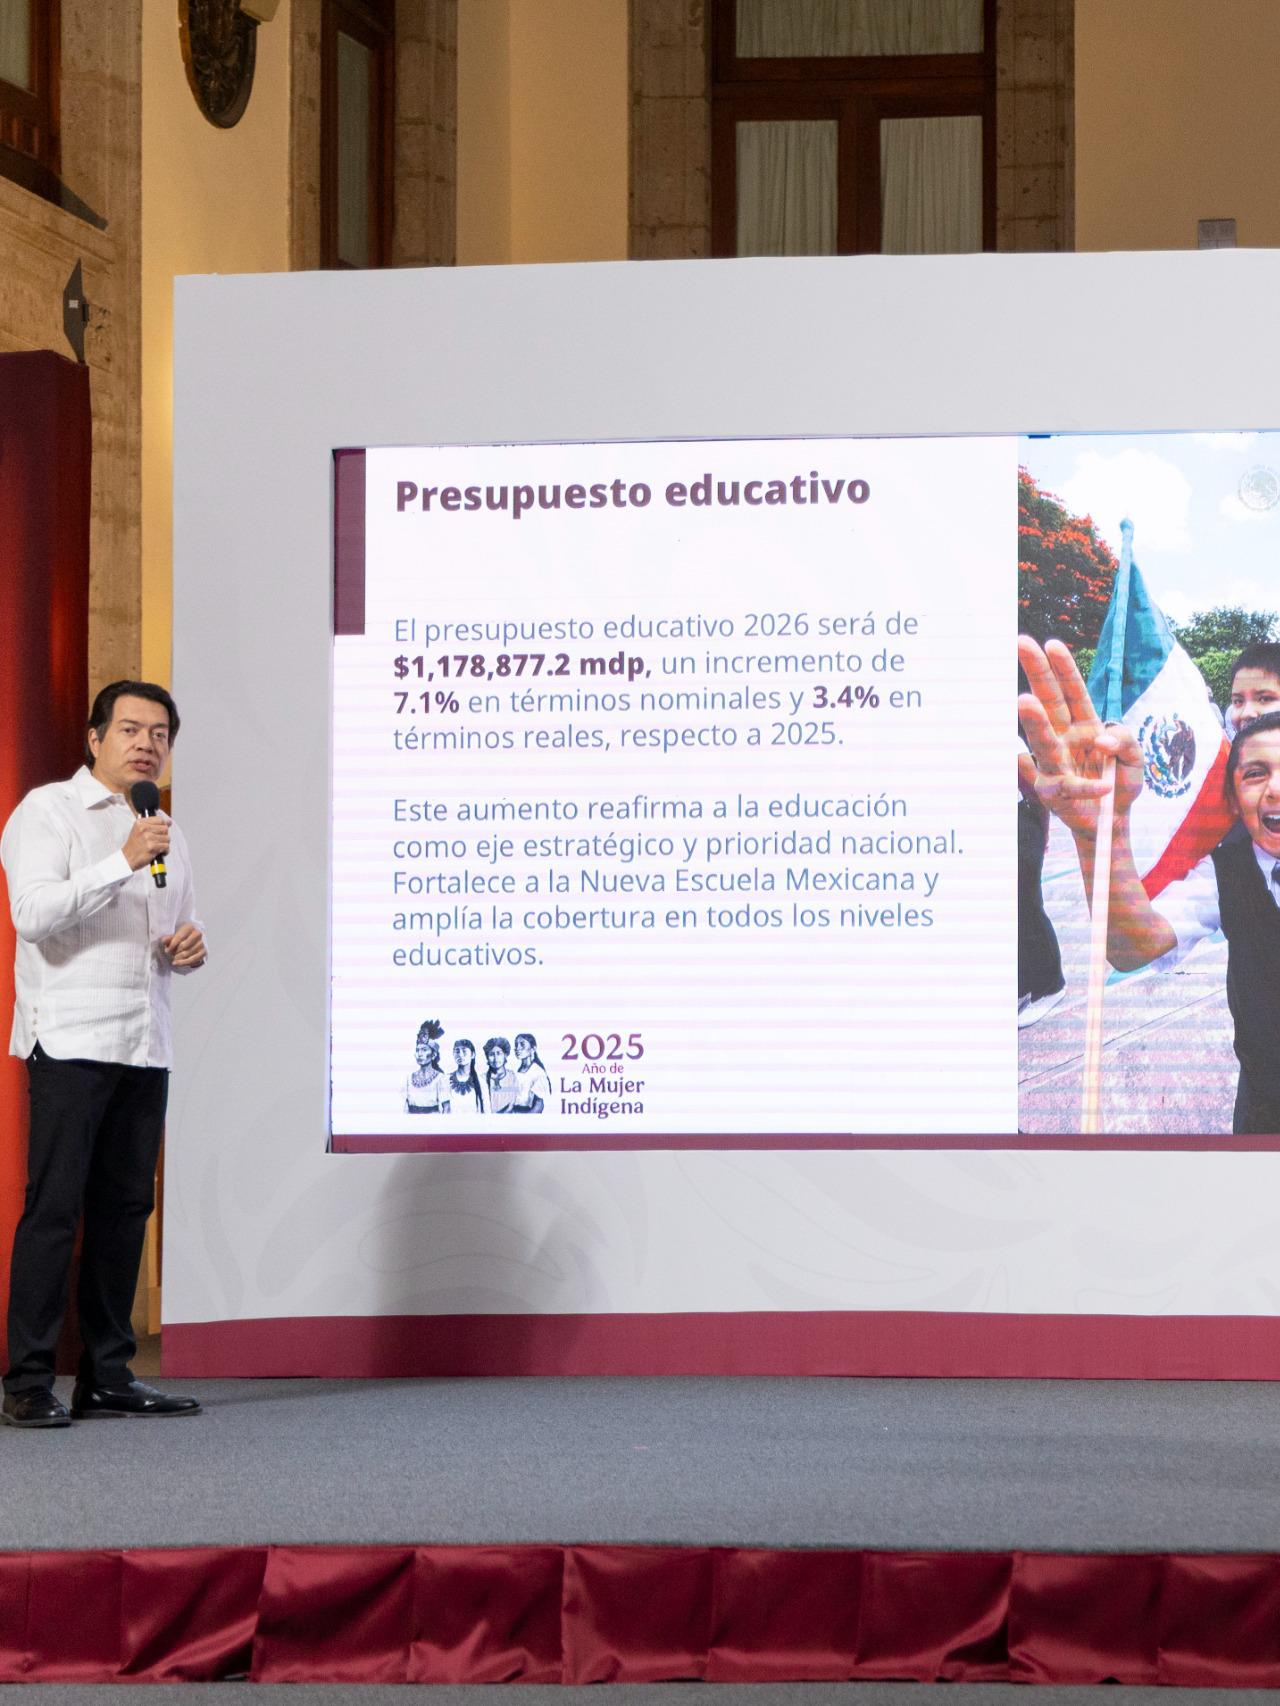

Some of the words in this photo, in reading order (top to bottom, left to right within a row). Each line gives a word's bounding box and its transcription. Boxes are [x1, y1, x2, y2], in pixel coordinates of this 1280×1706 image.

[396, 478, 652, 520] Presupuesto
[664, 470, 871, 508] educativo
[395, 617, 416, 642] El
[425, 618, 594, 649] presupuesto
[603, 613, 735, 639] educativo
[744, 612, 809, 637] 2026
[818, 610, 875, 636] será
[885, 610, 918, 636] de
[393, 652, 571, 683] $1,178,877.2
[579, 650, 652, 683] mdp,
[662, 656, 696, 675] un
[705, 650, 863, 674] incremento
[871, 647, 905, 673] de
[393, 690, 461, 715] 7.1%
[468, 695, 501, 714] en
[509, 687, 632, 713] términos
[640, 685, 782, 711] nominales
[789, 690, 805, 717] y
[812, 685, 882, 710] 3.4%
[888, 689, 923, 709] en
[393, 725, 515, 751] términos
[524, 723, 611, 752] reales,
[621, 724, 738, 754] respecto
[746, 727, 761, 746] a
[770, 721, 844, 746] 2025.
[394, 798, 448, 822] Este
[456, 797, 579, 822] aumento
[588, 794, 703, 820] reafirma
[712, 800, 727, 819] a
[737, 793, 759, 818] la
[768, 792, 907, 818] educación
[393, 839, 467, 859] como
[476, 833, 514, 865] eje
[523, 831, 674, 864] estratégico
[682, 837, 698, 863] y
[706, 829, 831, 863] prioridad
[842, 829, 963, 855] nacional.
[393, 869, 516, 895] Fortalece
[525, 875, 539, 894] a
[549, 868, 570, 893] la
[581, 869, 665, 893] Nueva
[676, 866, 775, 892] Escuela
[786, 867, 915, 891] Mexicana
[923, 872, 940, 898] y
[392, 905, 483, 938] amplía
[492, 904, 513, 930] la
[523, 904, 655, 930] cobertura
[665, 909, 697, 929] en
[706, 903, 783, 928] todos
[793, 902, 831, 928] los
[840, 902, 934, 928] niveles
[392, 941, 544, 967] educativos.
[560, 1032, 645, 1061] 2025
[581, 1062, 607, 1074] Año
[609, 1061, 625, 1074] de
[560, 1076, 582, 1094] La
[588, 1076, 646, 1099] Mujer
[560, 1096, 644, 1120] Indígena
